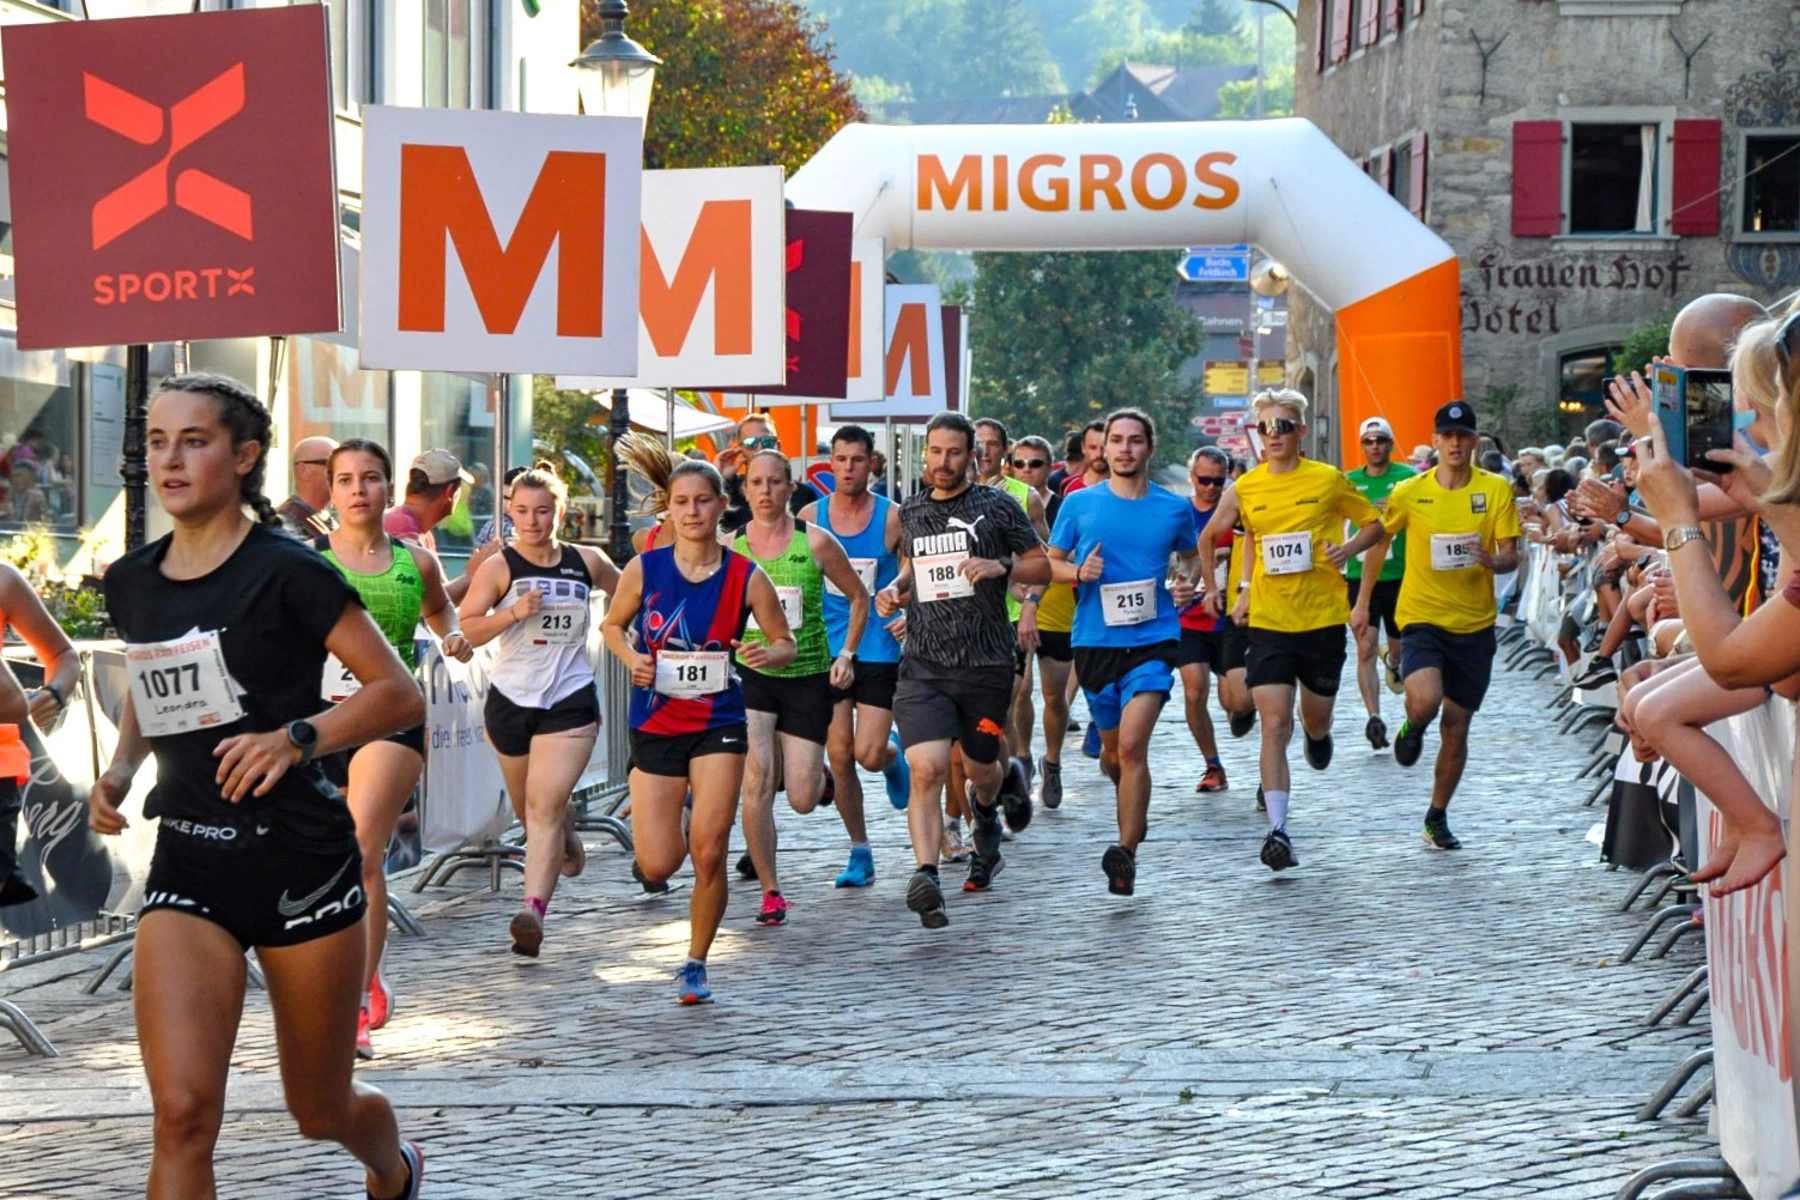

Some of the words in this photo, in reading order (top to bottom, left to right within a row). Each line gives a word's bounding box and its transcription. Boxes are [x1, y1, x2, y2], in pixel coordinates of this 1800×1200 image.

[917, 151, 1240, 212] MIGROS
[398, 143, 607, 338] M
[93, 266, 255, 305] SPORTX
[640, 199, 752, 357] M
[913, 531, 968, 557] PUMA
[1269, 542, 1303, 558] 1074
[928, 565, 955, 582] 188
[1116, 592, 1145, 608] 215
[541, 614, 572, 630] 213
[138, 661, 200, 700] 1077
[676, 665, 708, 682] 181
[191, 824, 238, 841] PRO
